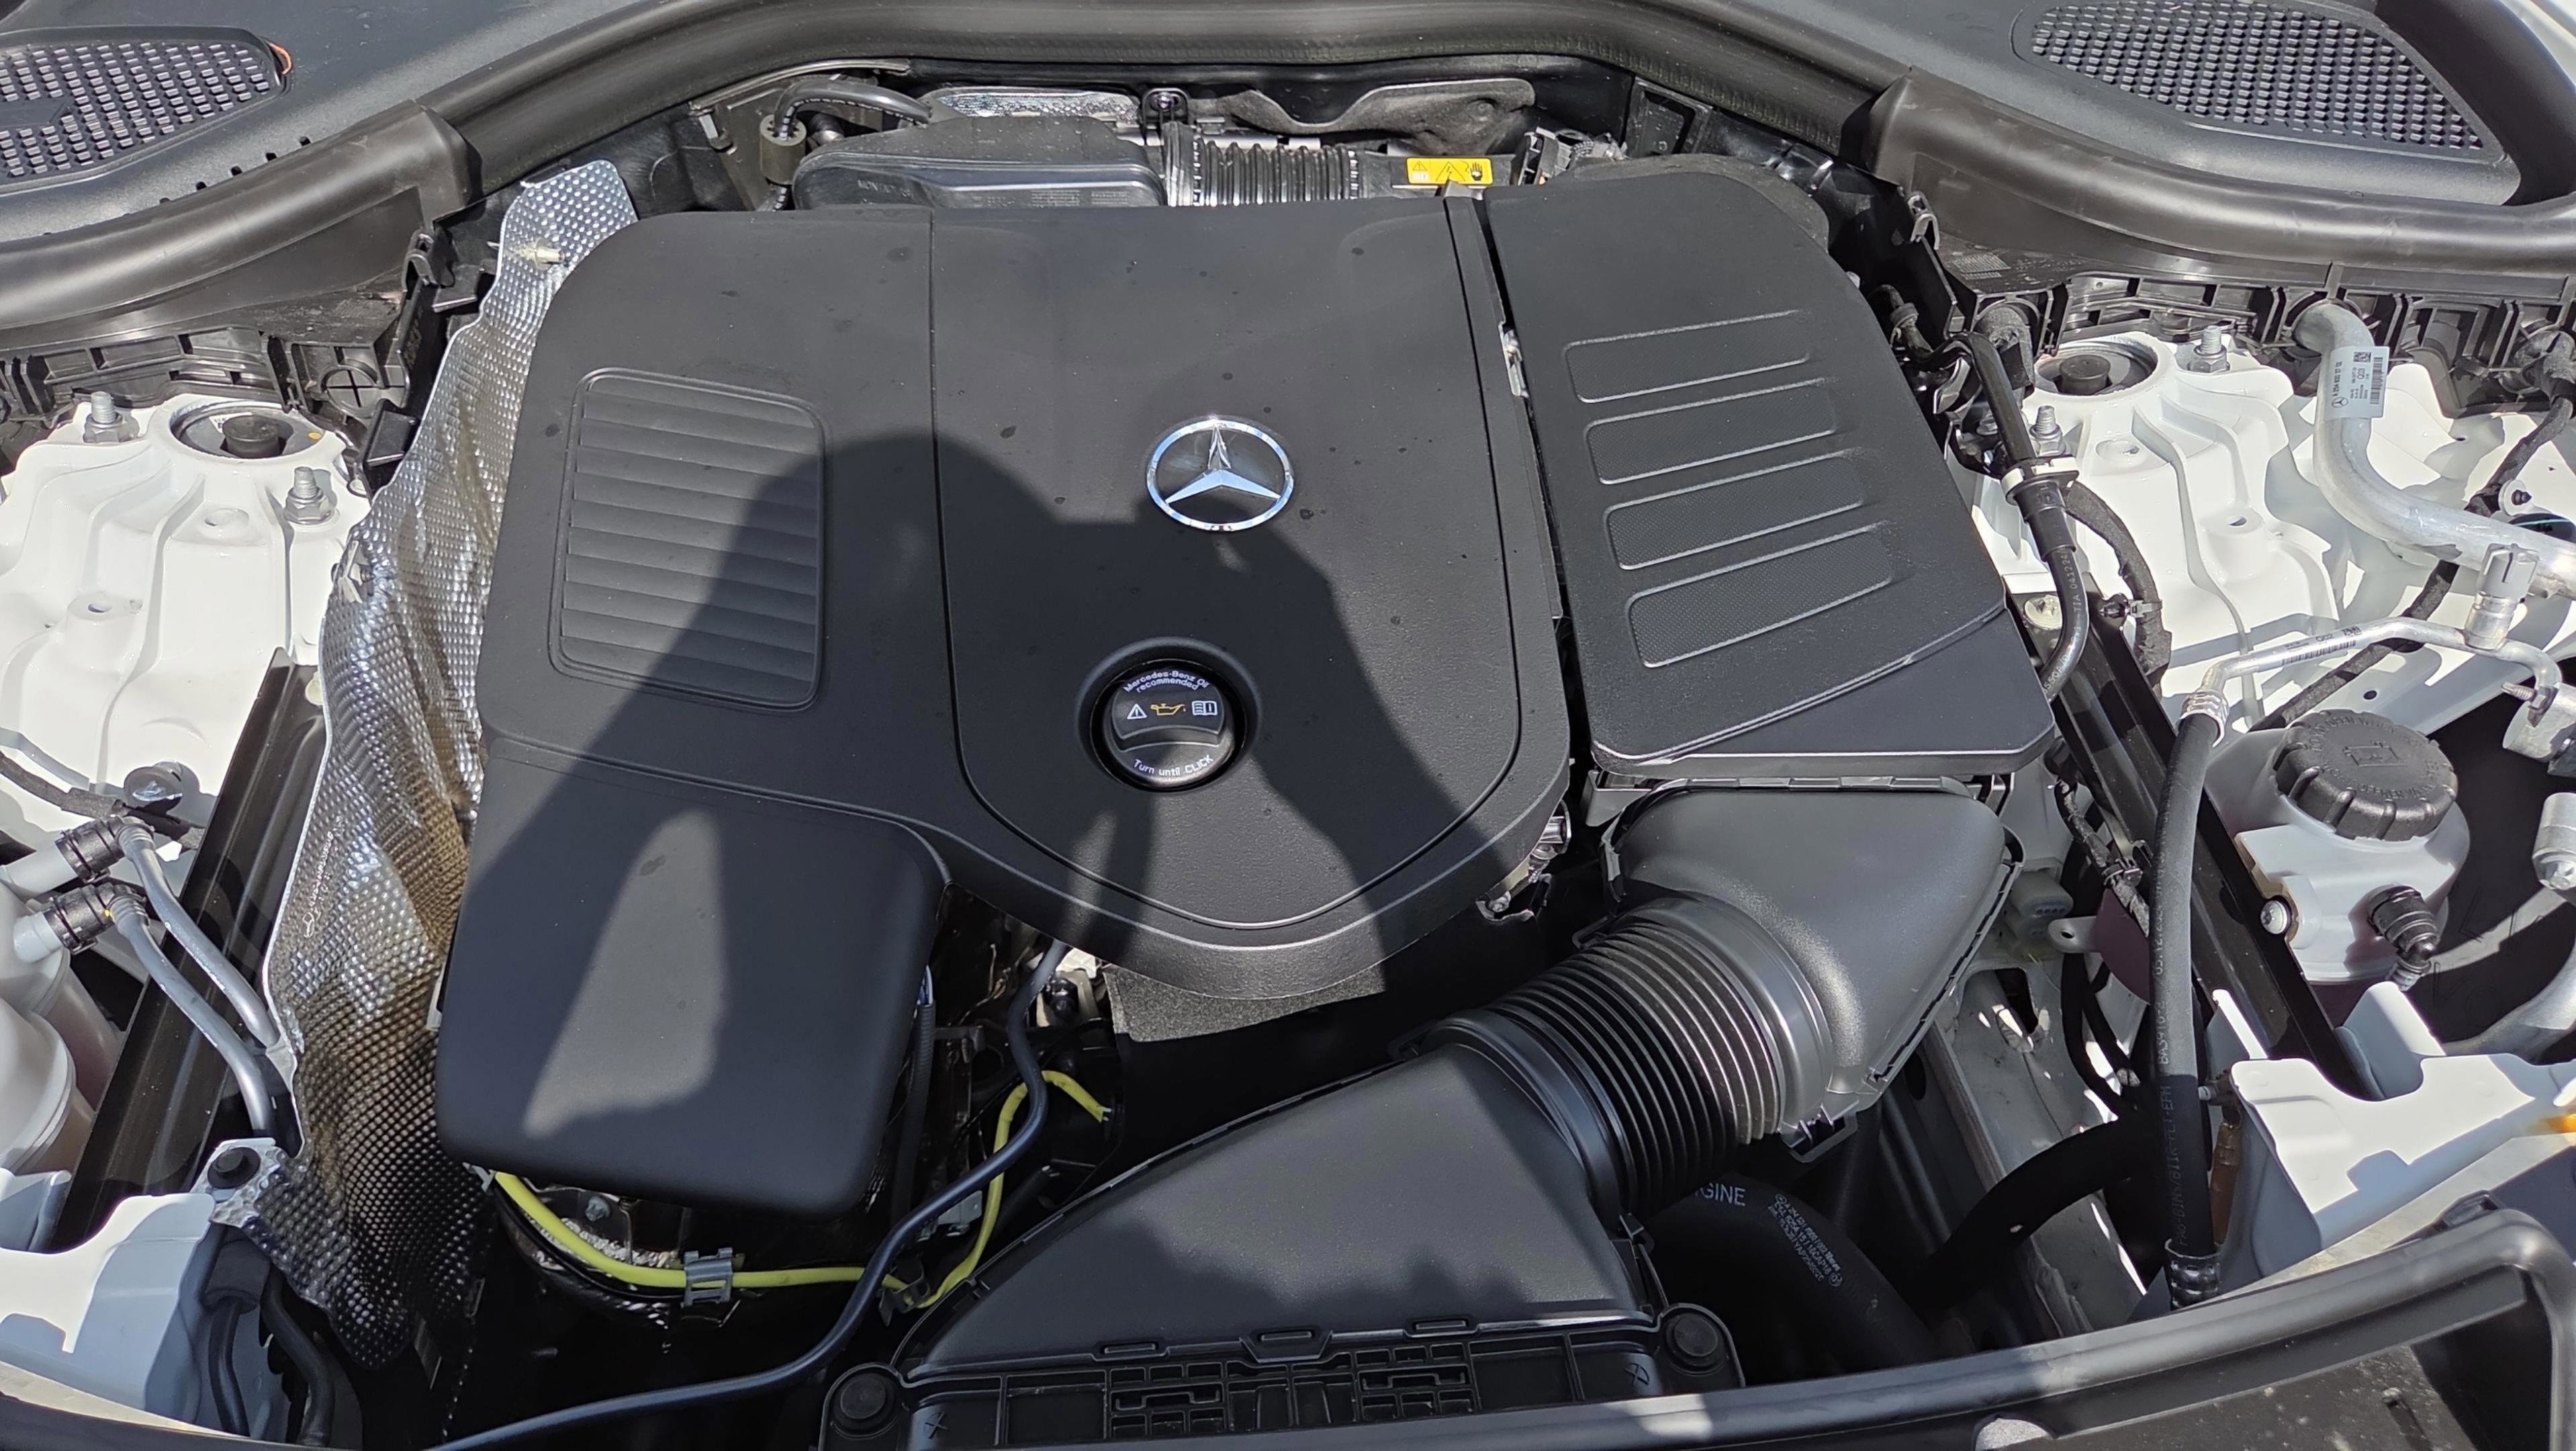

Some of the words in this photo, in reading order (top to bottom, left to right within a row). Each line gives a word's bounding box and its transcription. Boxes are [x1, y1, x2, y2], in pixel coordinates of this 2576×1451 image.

[1123, 670, 1196, 693] Mercedes-Benz
[1197, 678, 1209, 689] Oil
[1136, 678, 1200, 693] recommended
[1134, 759, 1155, 775] Turn
[1158, 767, 1181, 777] until
[1185, 754, 1215, 774] CLICK
